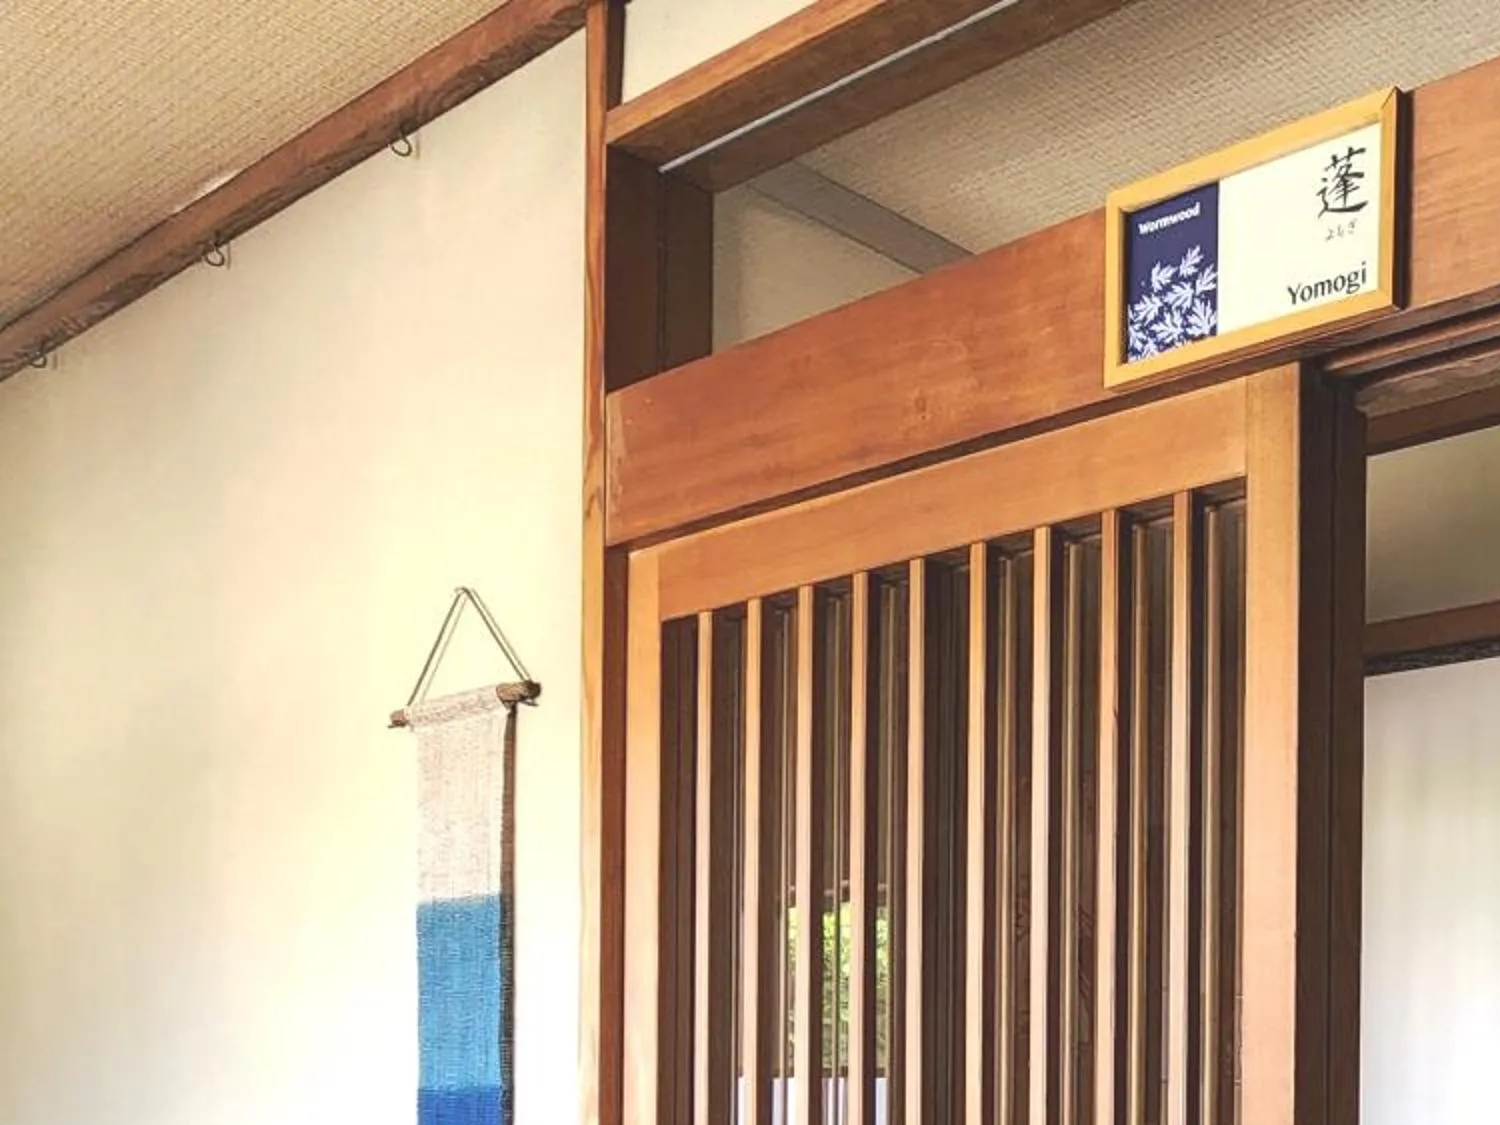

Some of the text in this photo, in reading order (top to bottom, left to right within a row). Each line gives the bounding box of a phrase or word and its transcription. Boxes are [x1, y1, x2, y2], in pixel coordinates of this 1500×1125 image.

[1316, 146, 1369, 220] 蓬
[1138, 202, 1201, 235] Wormwood
[1286, 260, 1368, 305] Yomogi
